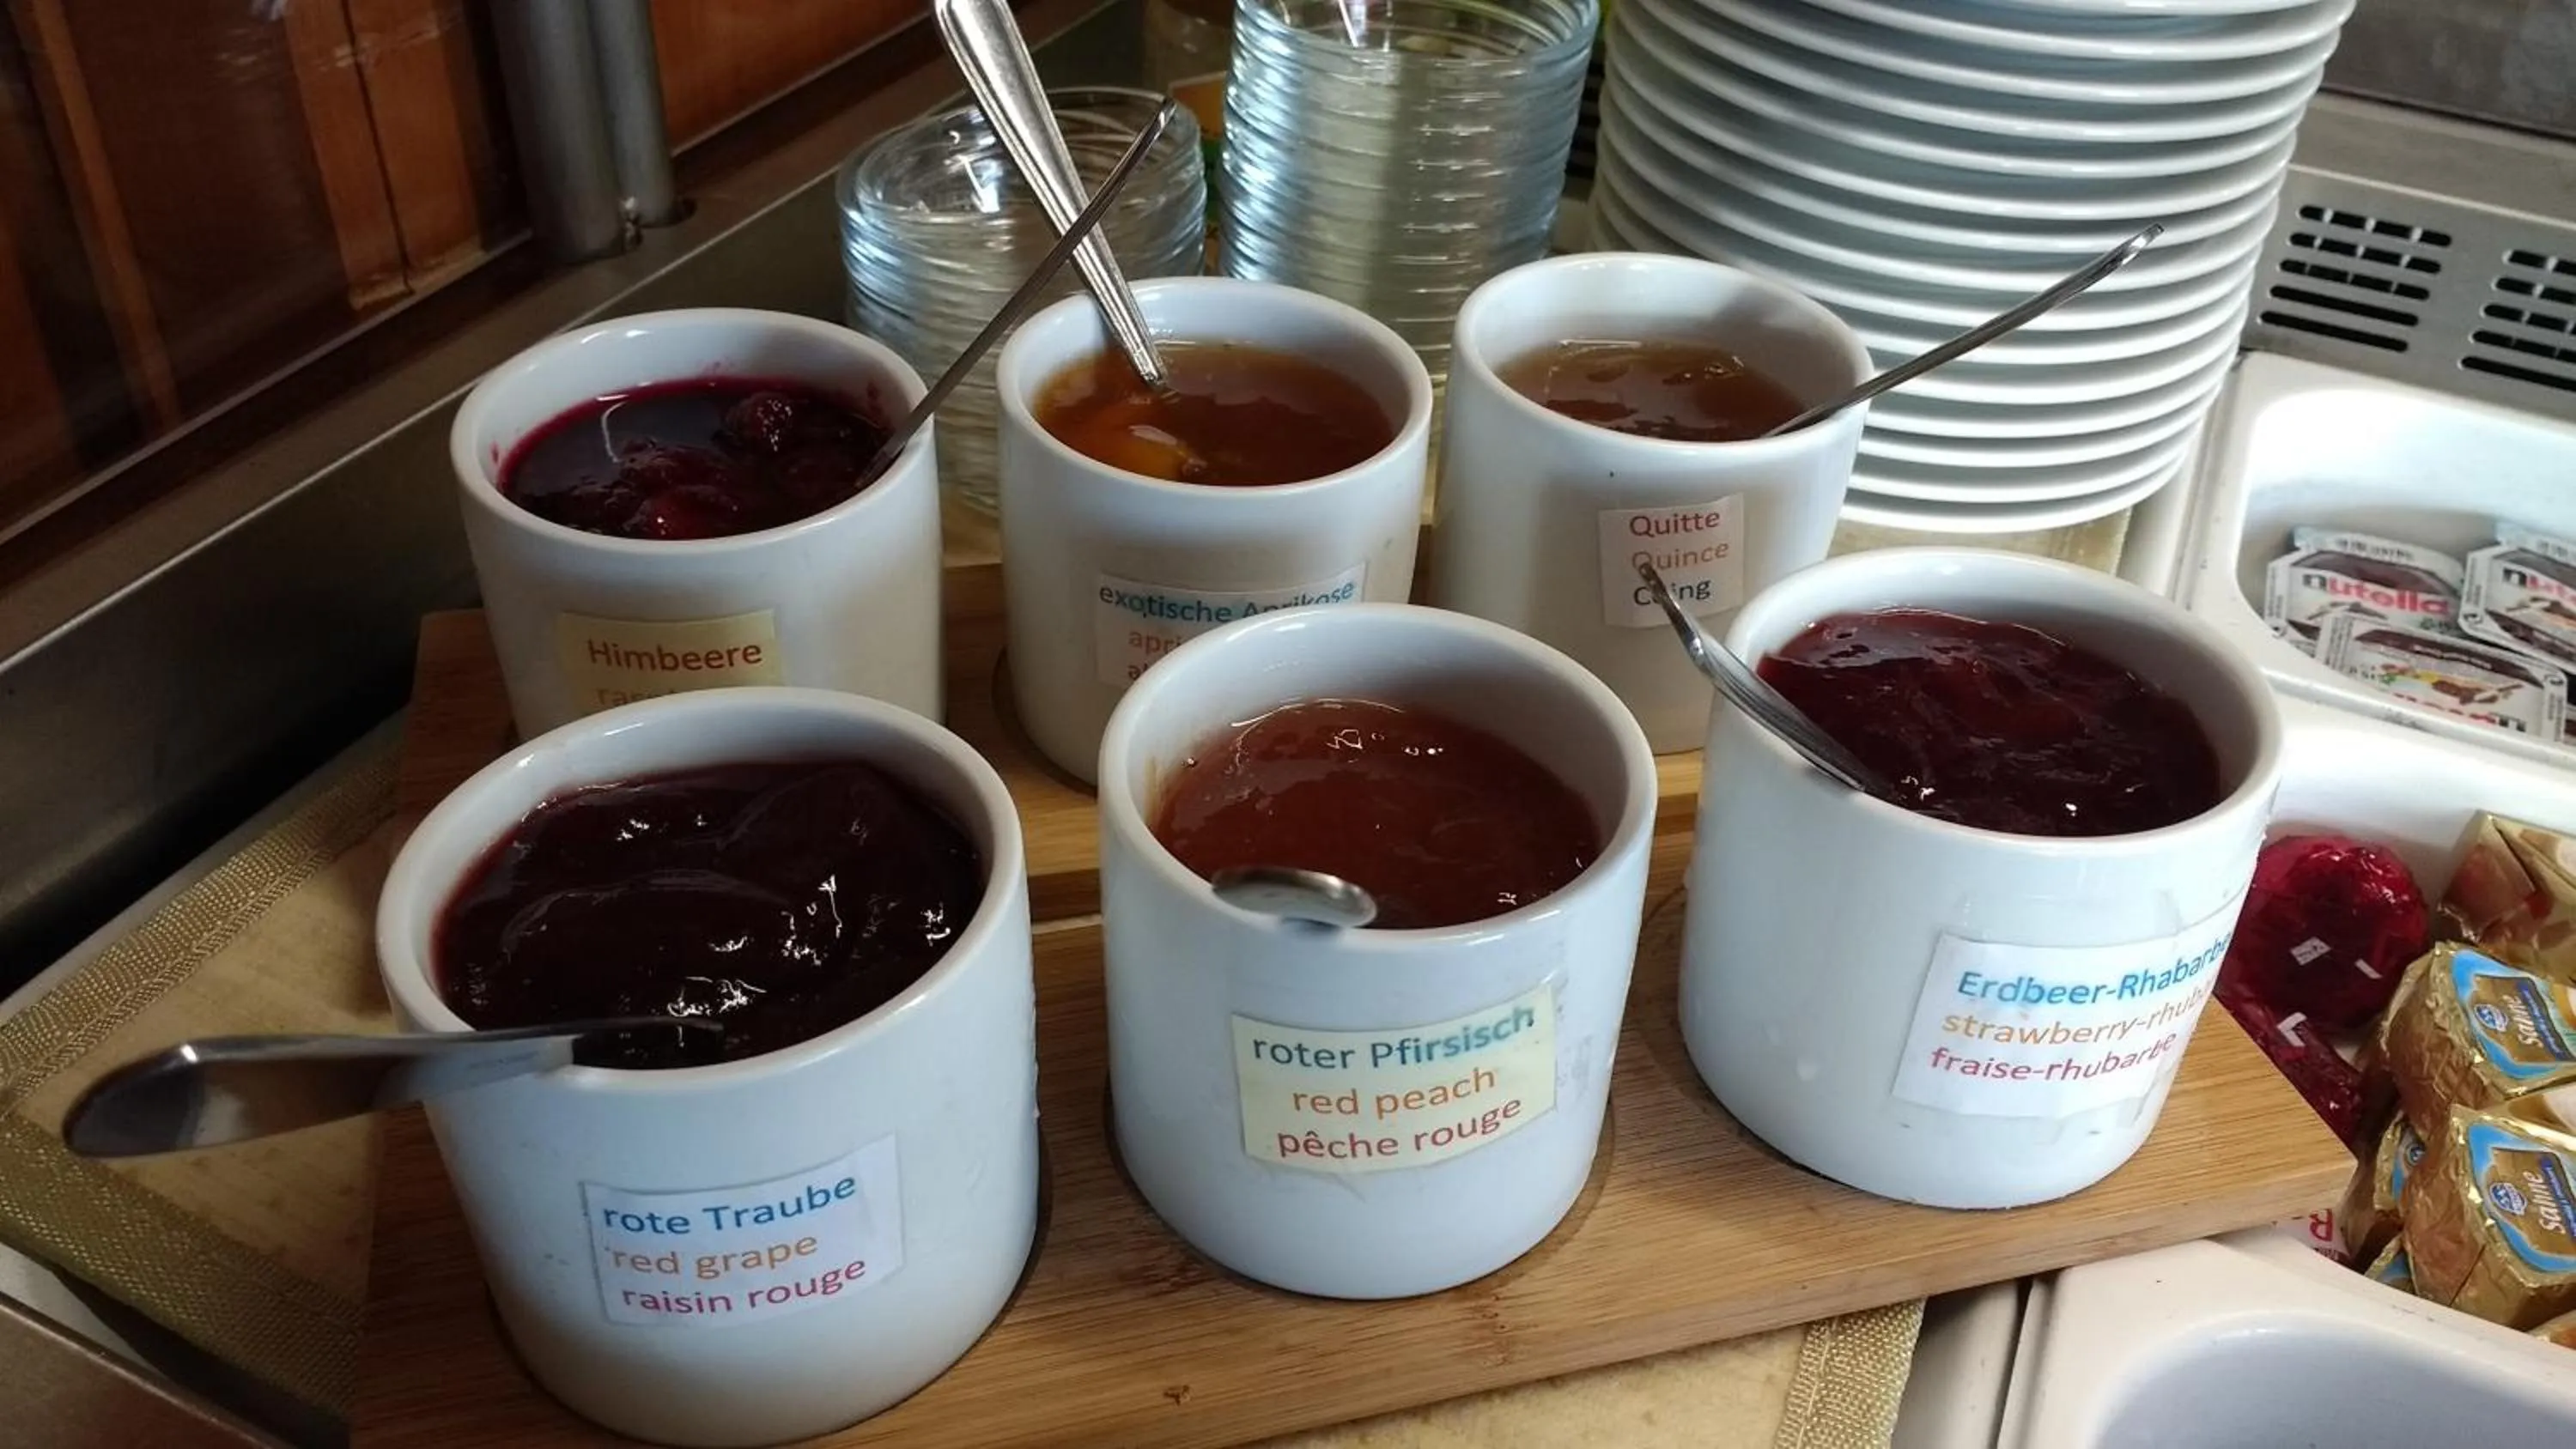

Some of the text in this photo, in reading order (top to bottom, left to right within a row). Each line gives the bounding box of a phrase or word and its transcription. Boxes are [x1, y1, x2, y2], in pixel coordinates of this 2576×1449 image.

[1629, 512, 1720, 537] Quitte
[1632, 543, 1728, 570] Quince
[1099, 585, 1232, 623] exotische
[1634, 579, 1711, 606] Cing
[2302, 574, 2449, 615] nutella
[587, 639, 763, 671] Himbeere
[1253, 1007, 1534, 1070] roter Pfirsisch
[1931, 1032, 2177, 1081] fraise-rhubarbe
[1293, 1067, 1496, 1120] red peach
[1278, 1098, 1522, 1159] pêche rouge
[604, 1176, 856, 1234] rote Traube
[611, 1236, 817, 1280] red grape
[623, 1259, 866, 1314] raisin rouge
